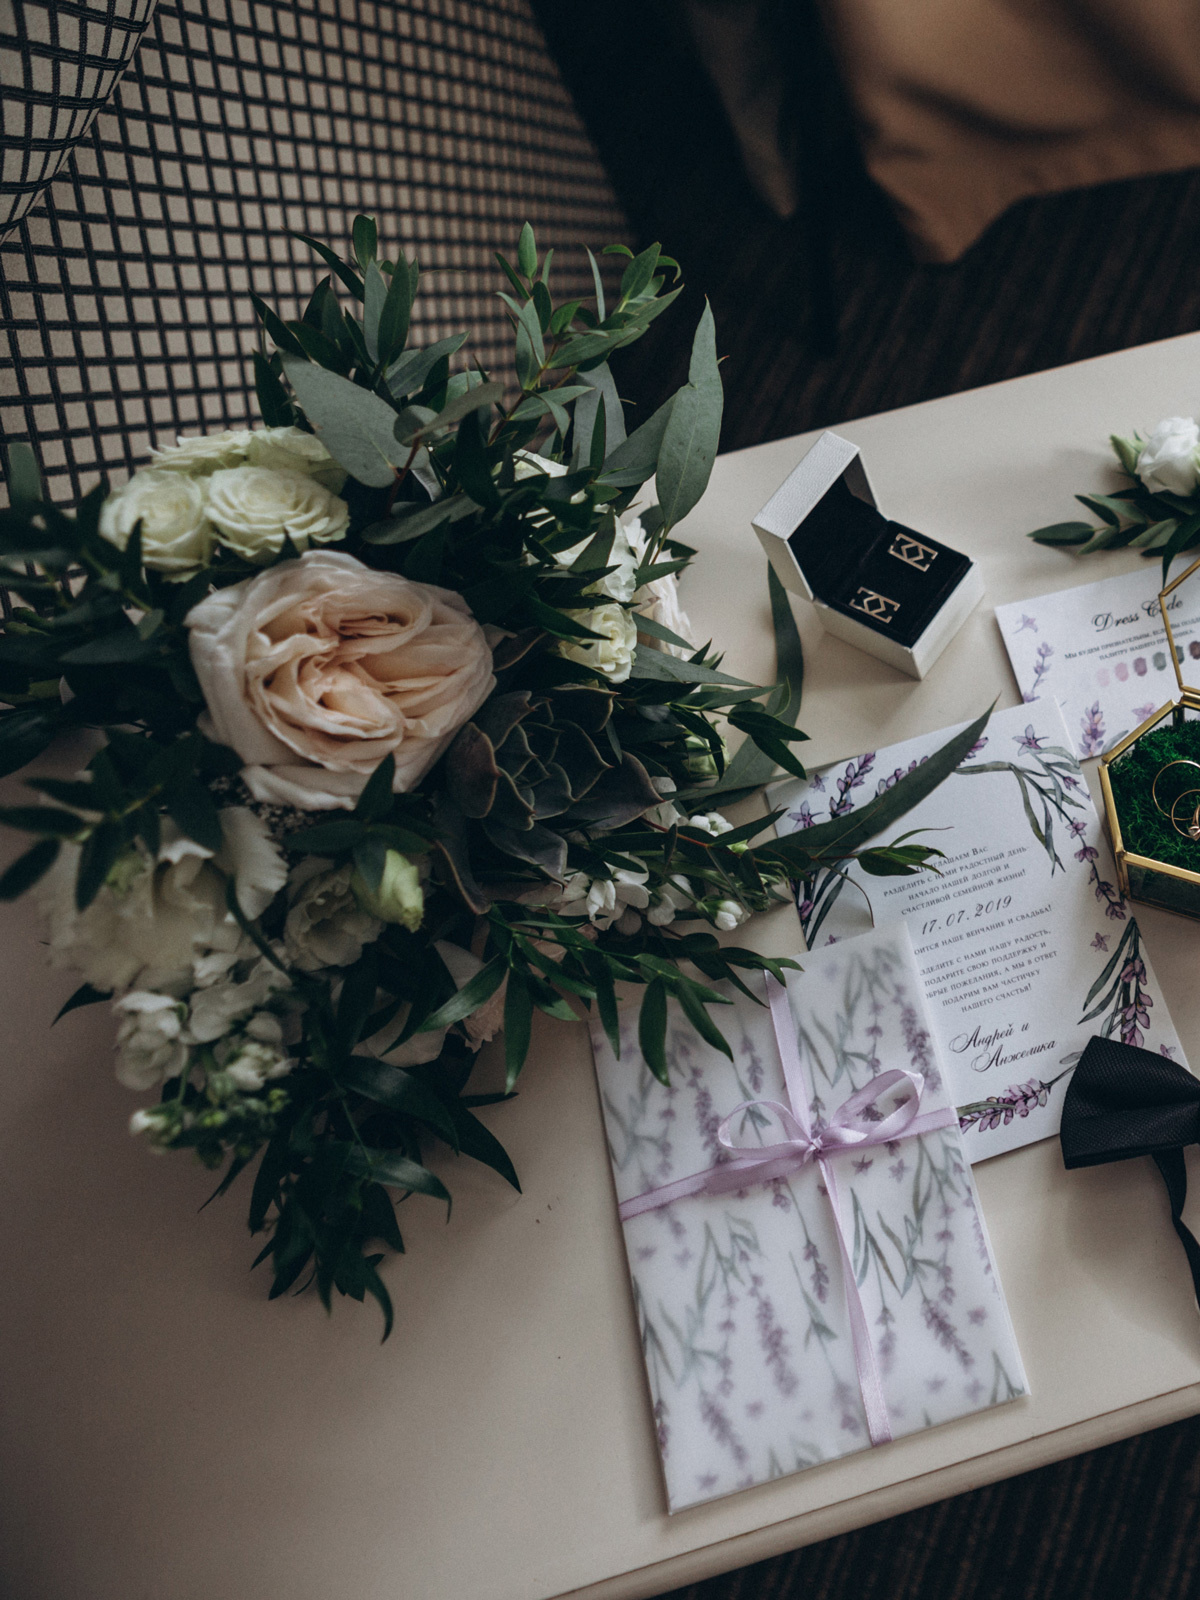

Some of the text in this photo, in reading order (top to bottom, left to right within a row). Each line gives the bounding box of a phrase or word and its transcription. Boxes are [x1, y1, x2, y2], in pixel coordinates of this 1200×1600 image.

[1091, 594, 1183, 632] Dress Cde
[1152, 626, 1166, 635] ЕСЛ
[884, 879, 925, 897] РАЗДЕЛИТЬ
[959, 852, 1005, 872] РАДОСТНЫЙ
[901, 869, 1026, 915] СЧАСТЛИВОЙ СЕМЕЙНОЙ ЖИЗНИ!
[908, 863, 1011, 900] НАЧАЛО НАШЕЙ ДОЛГОЙ И
[914, 942, 939, 955] ОИТСЯ
[941, 935, 964, 946] НАШЕ
[966, 921, 1005, 938] ВЕНЧАНИЕ
[1016, 904, 1052, 921] СВАДЬБА!
[920, 960, 954, 975] ЗДЕЛИТЕ
[964, 949, 986, 960] НАМИ
[989, 941, 1011, 952] НАШУ
[1014, 929, 1051, 944] РАДОСТЬ,
[925, 969, 965, 986] ПОДАРИТЕ
[967, 961, 989, 972] СВОЮ
[991, 945, 1037, 964] ПОДДЕРЖКУ
[950, 970, 1002, 990] ПОЖЕЛАНИЯ,
[1012, 961, 1026, 971] МЫ
[1034, 951, 1057, 963] ОТВЕТ
[942, 969, 1040, 1006] ПОДАРИМ ВАМ ЧАСТИЧКУ
[961, 983, 1031, 1013] НАШЕГО СЧАСТЬЯ!
[949, 1023, 1030, 1053] Андрей и
[971, 1041, 1055, 1072] Анжелика
